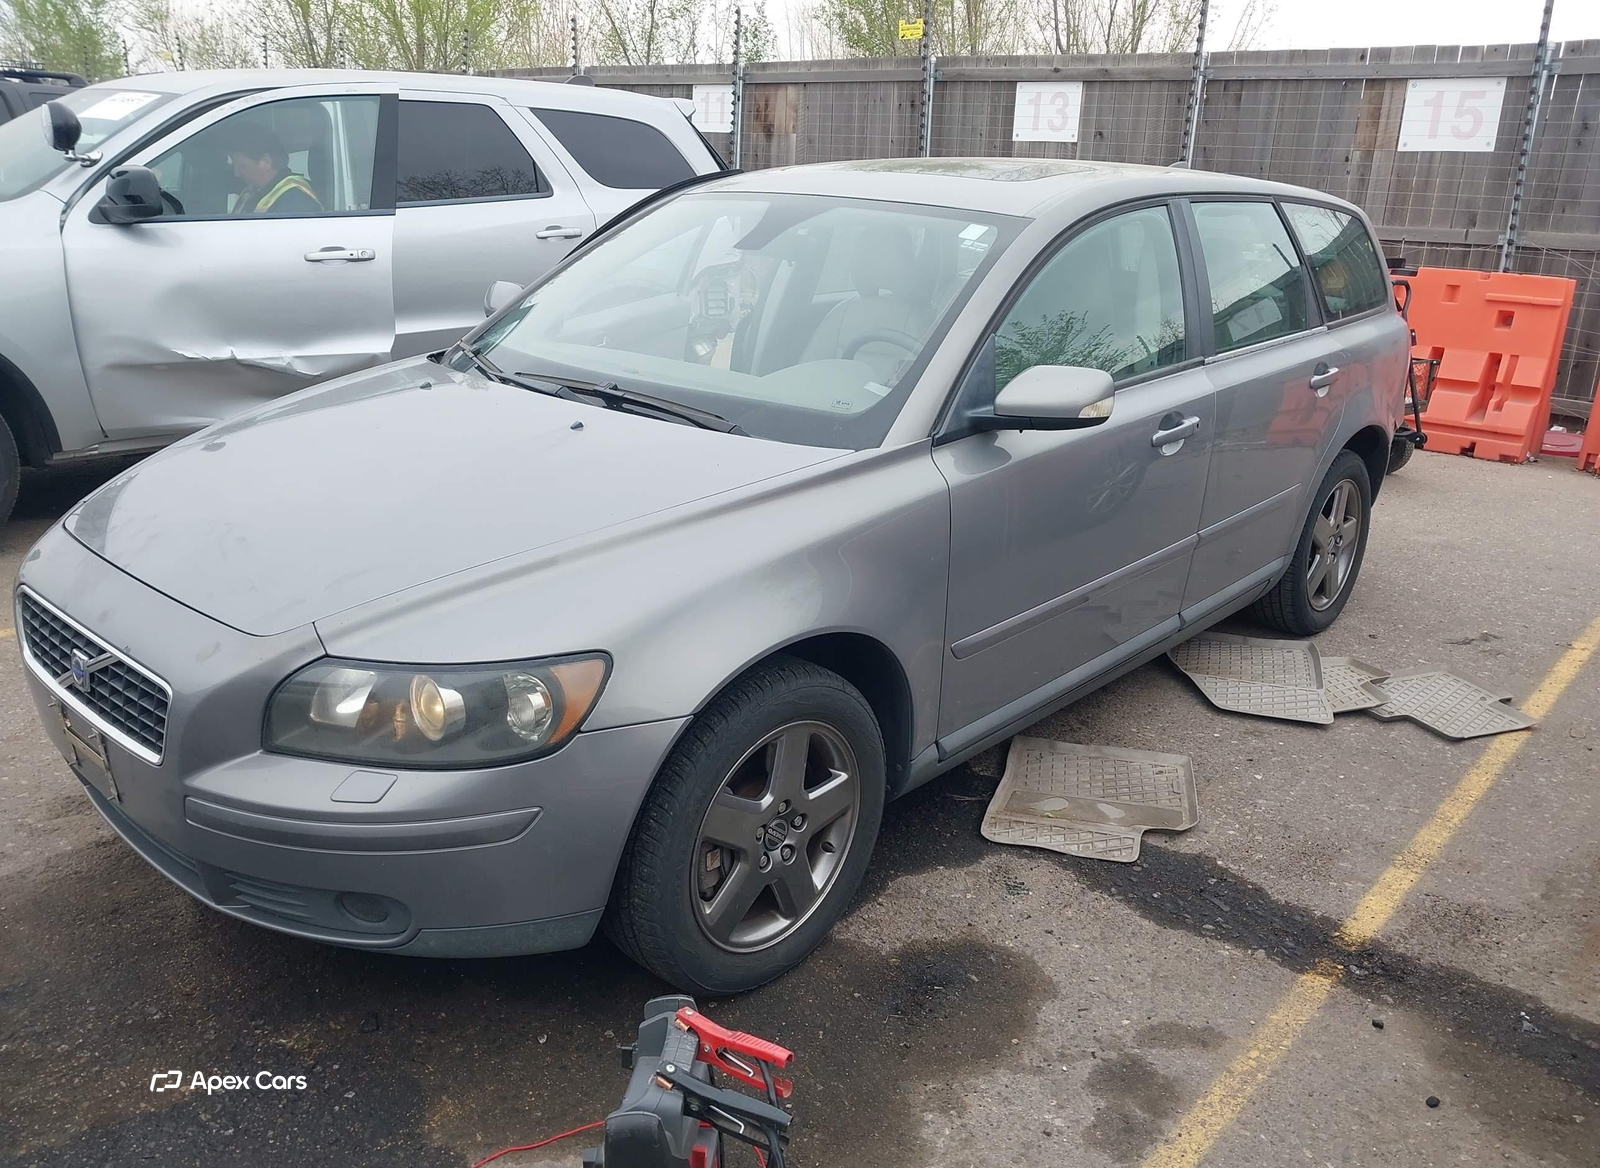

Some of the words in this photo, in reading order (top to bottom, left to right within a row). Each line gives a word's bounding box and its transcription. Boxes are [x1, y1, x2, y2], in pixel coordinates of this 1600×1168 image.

[700, 91, 726, 124] 11
[1027, 91, 1070, 133] 13
[1423, 90, 1487, 140] 15
